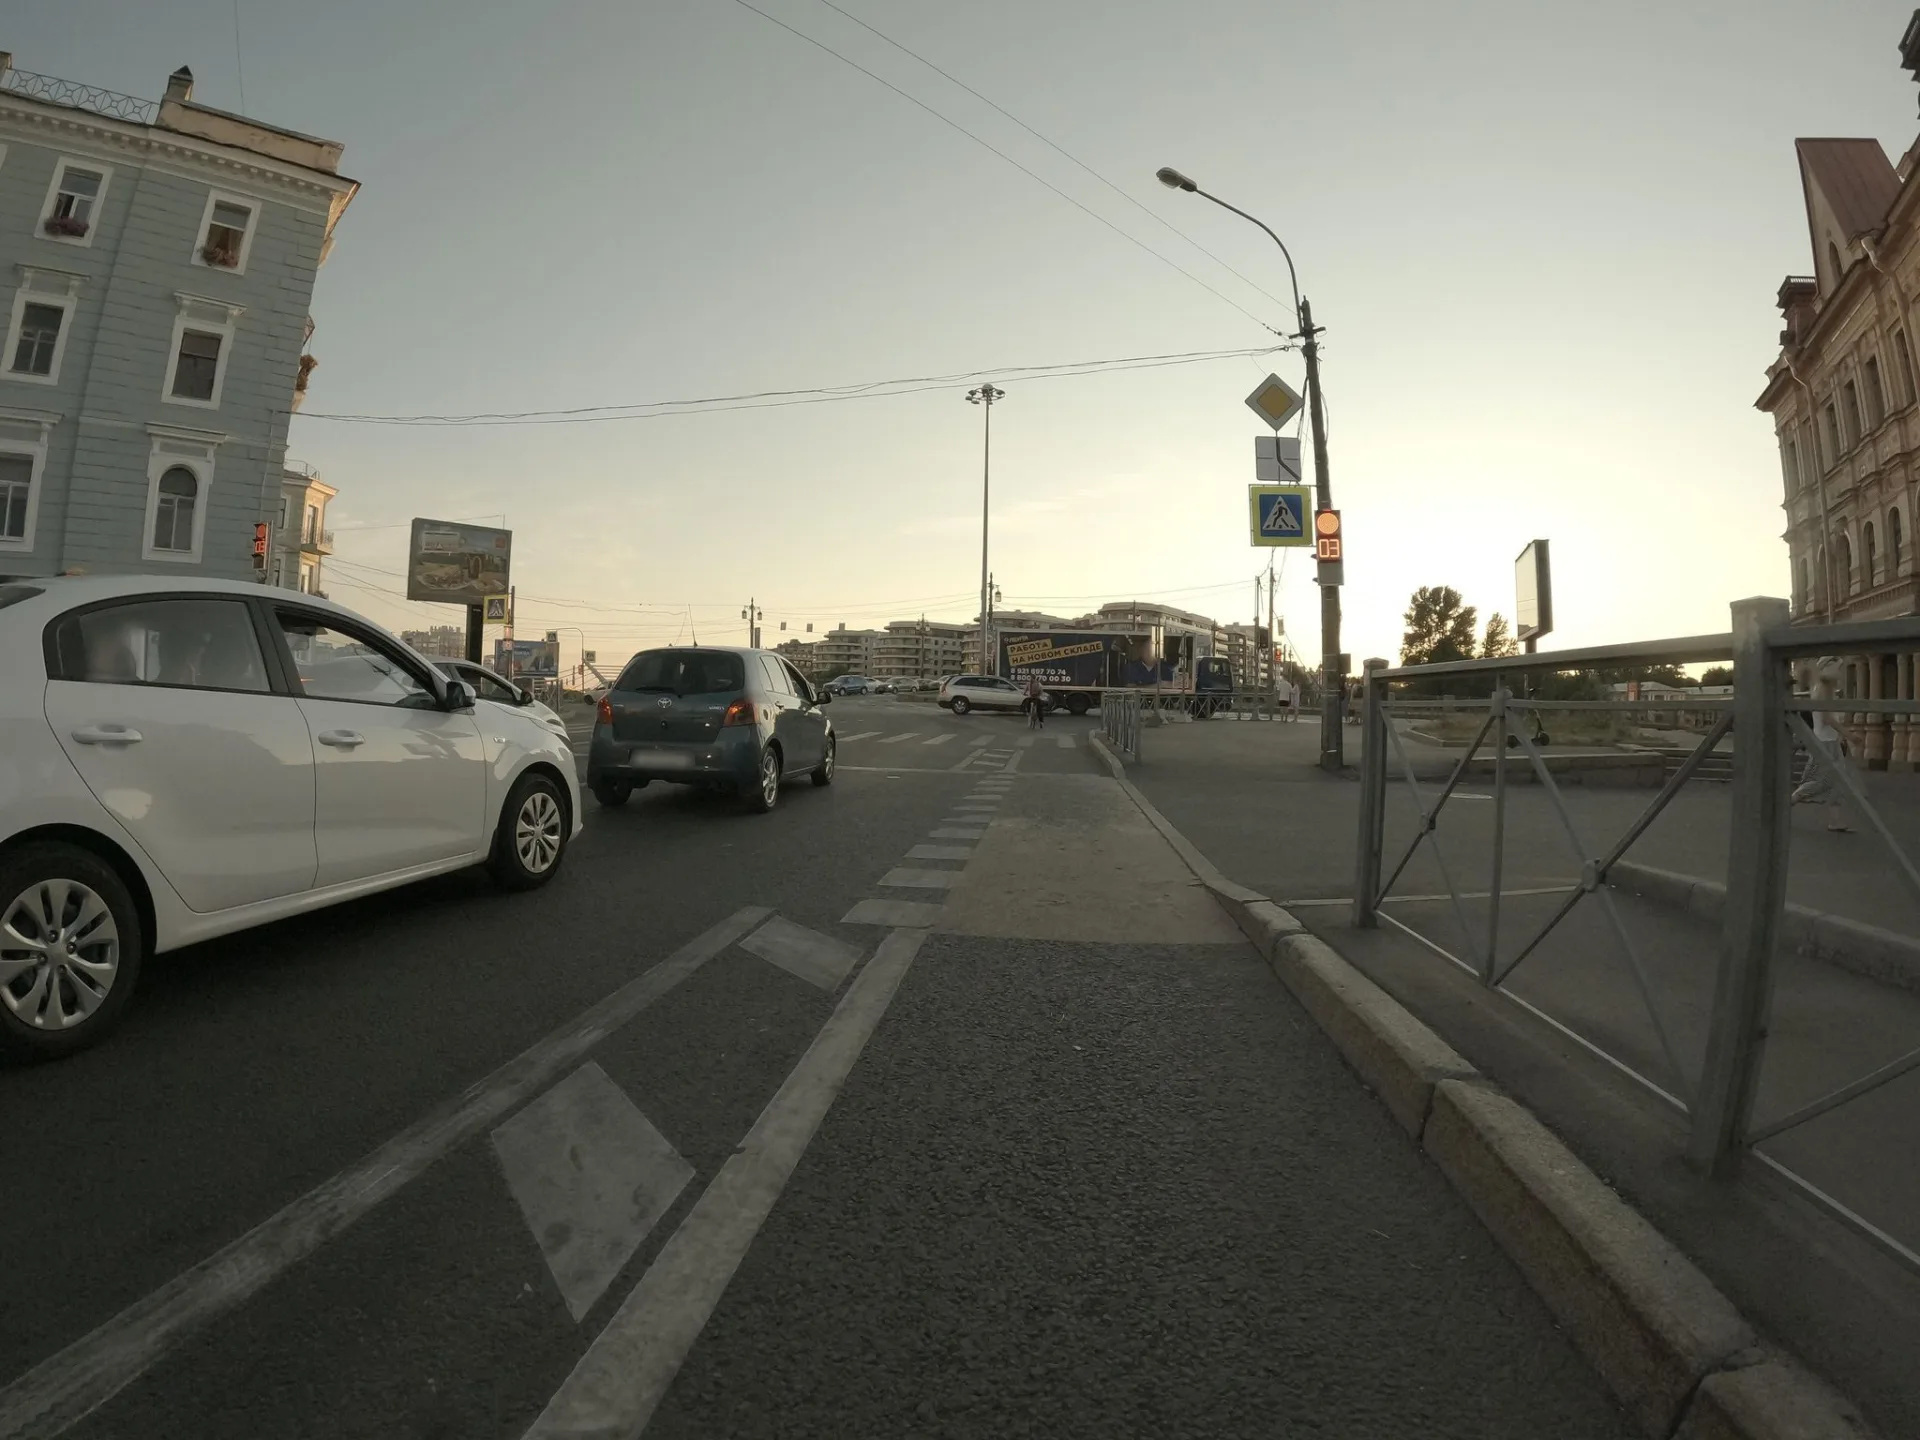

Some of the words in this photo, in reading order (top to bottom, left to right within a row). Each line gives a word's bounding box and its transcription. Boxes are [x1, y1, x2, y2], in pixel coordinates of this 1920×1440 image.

[1319, 539, 1339, 557] 03
[1010, 642, 1049, 653] РАБОТА
[1012, 656, 1026, 664] НА
[1028, 651, 1062, 661] НОВОМ
[1064, 643, 1102, 655] СКЛАДЕ
